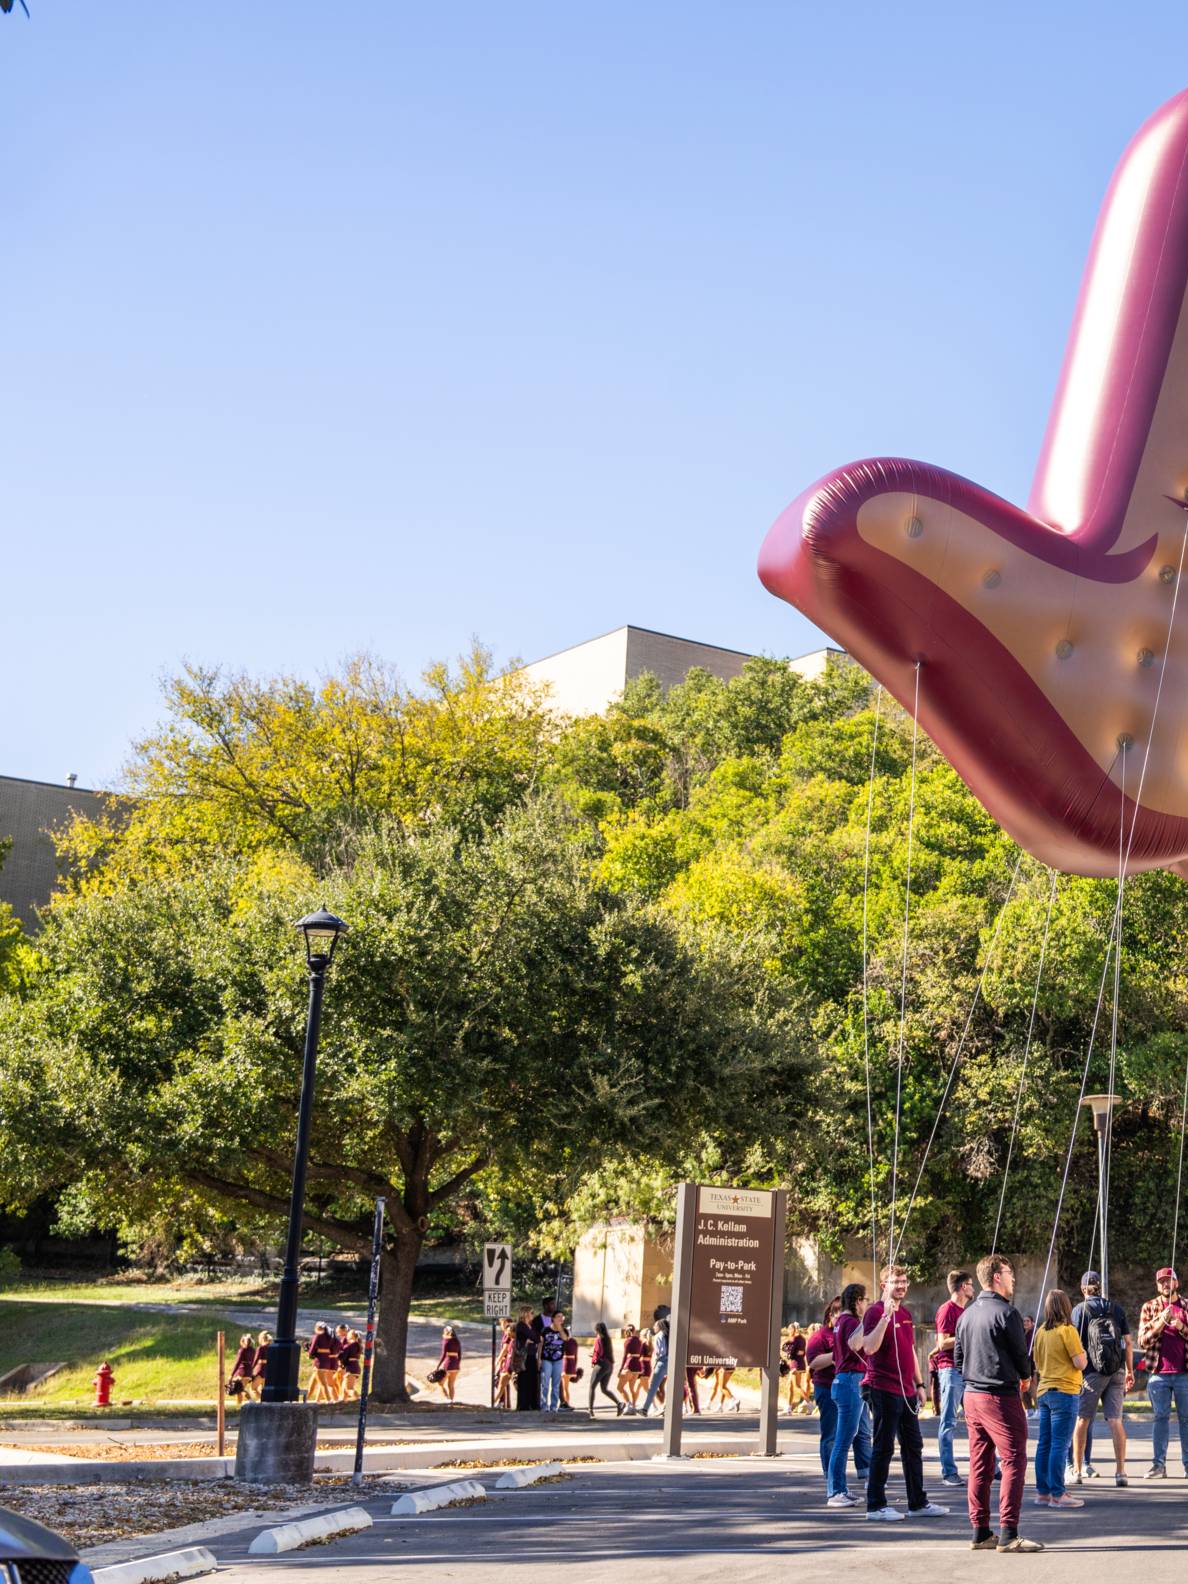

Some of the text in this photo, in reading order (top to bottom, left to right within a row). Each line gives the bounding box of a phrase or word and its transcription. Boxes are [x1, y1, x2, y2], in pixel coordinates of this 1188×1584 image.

[711, 1193, 760, 1203] TEXAS STATE
[717, 1204, 753, 1212] UNIVERSITY
[698, 1219, 747, 1232] J. C. Kellam
[697, 1234, 759, 1248] Administration
[710, 1258, 756, 1271] Pay-to-Park
[488, 1293, 506, 1302] KEEP
[486, 1305, 507, 1315] RIGHT
[690, 1355, 738, 1366] 601 University
